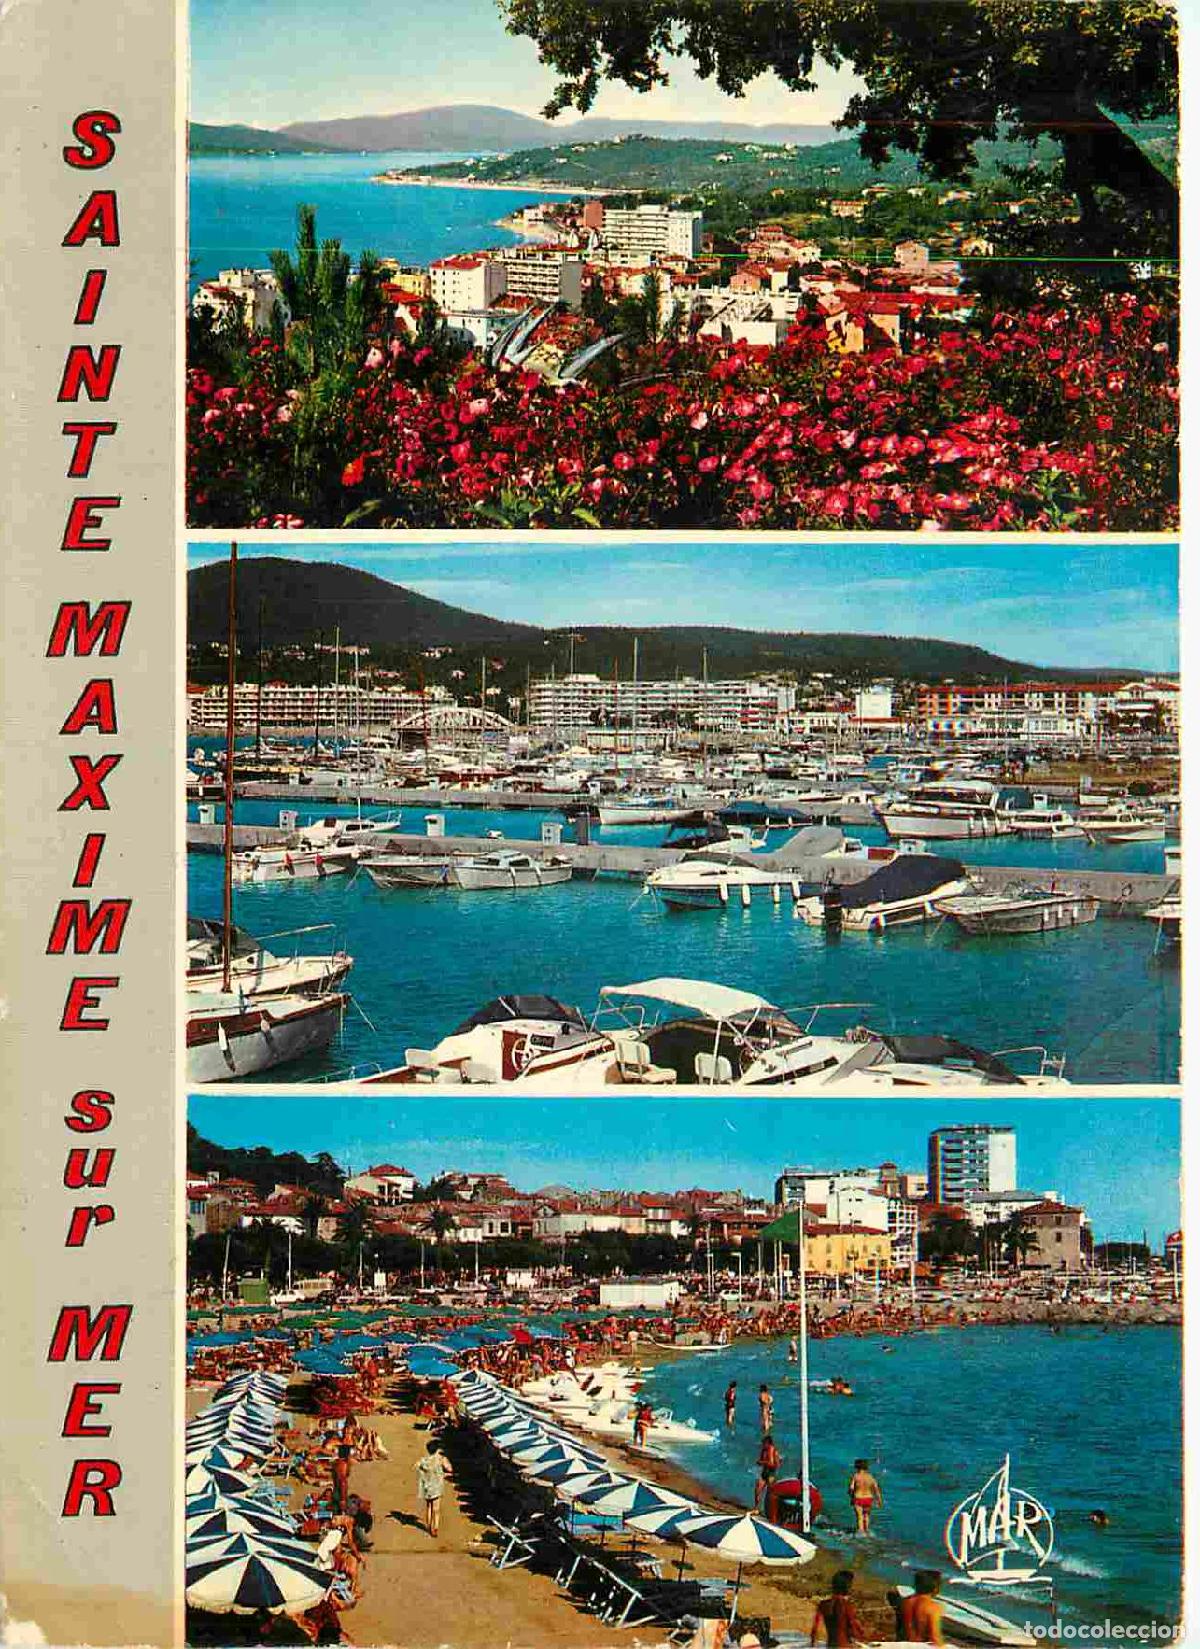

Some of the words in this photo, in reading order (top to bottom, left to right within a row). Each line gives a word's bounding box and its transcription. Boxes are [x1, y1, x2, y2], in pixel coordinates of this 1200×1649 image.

[57, 111, 122, 552] SAINTE
[46, 600, 132, 1031] MAXIME
[63, 1089, 116, 1248] sur
[46, 1304, 133, 1517] MER
[959, 1465, 1047, 1567] MAR
